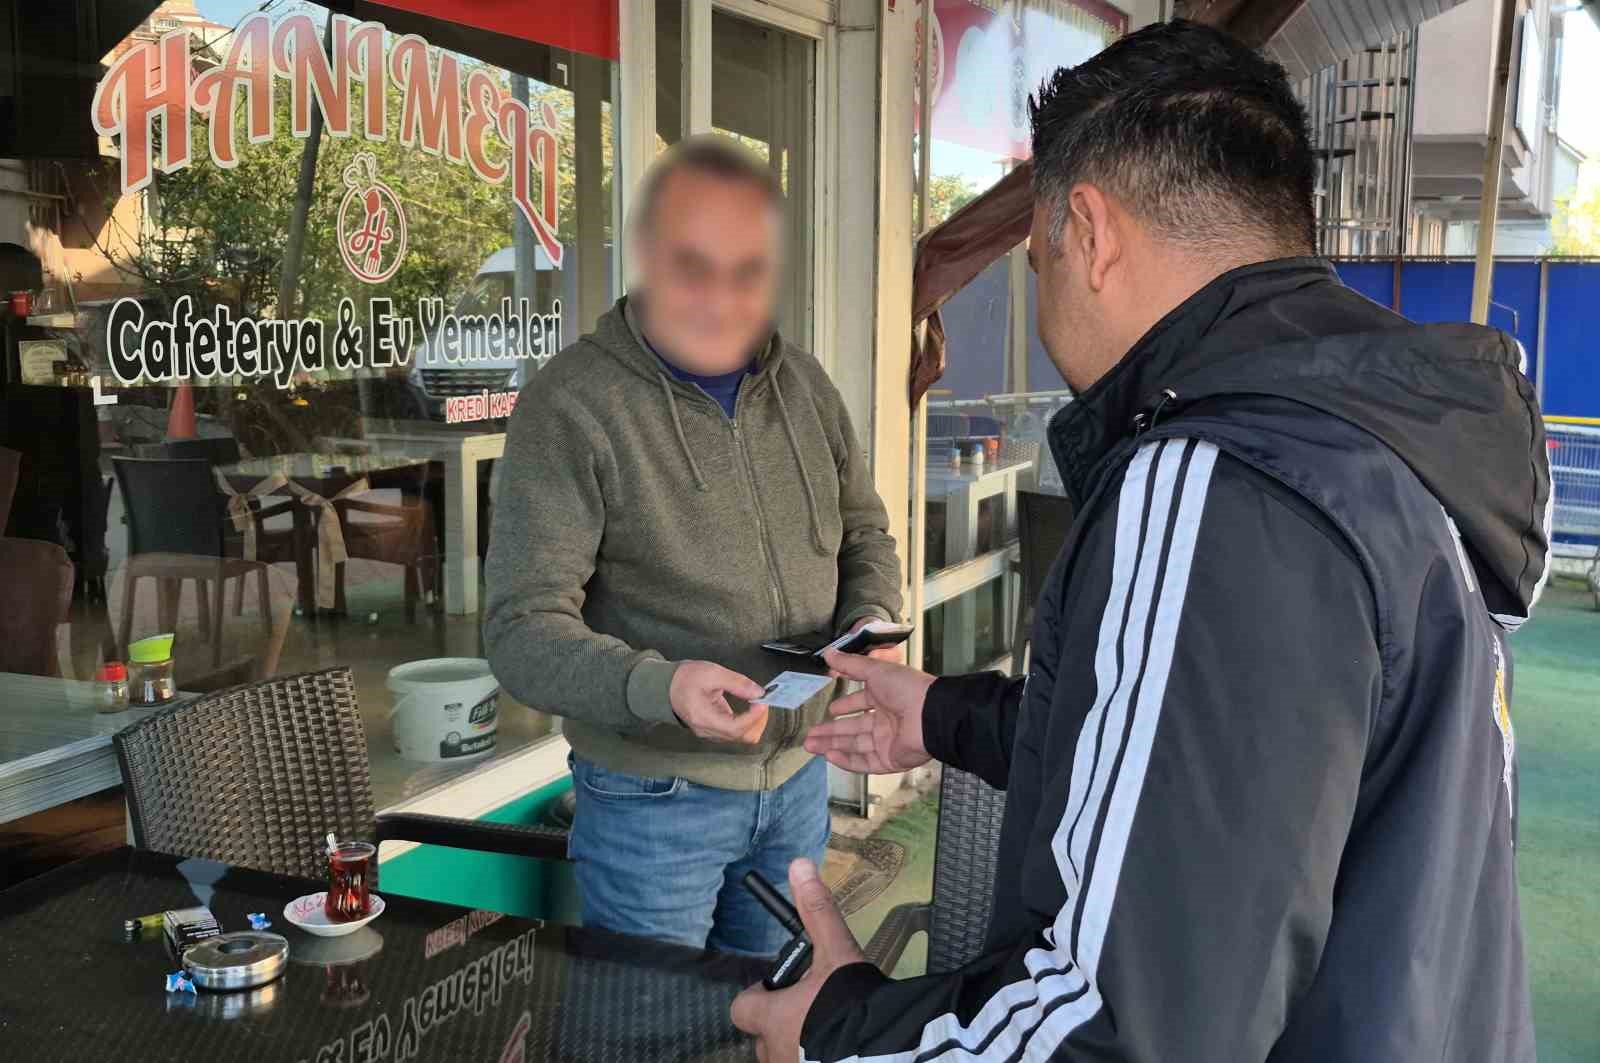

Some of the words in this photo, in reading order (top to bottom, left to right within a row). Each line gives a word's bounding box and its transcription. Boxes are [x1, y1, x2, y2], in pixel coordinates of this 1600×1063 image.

[107, 295, 325, 389] Cafeterya
[333, 297, 364, 370] &
[370, 297, 414, 367] Ev
[419, 296, 563, 364] Yemekleri
[446, 388, 489, 424] KREDİ
